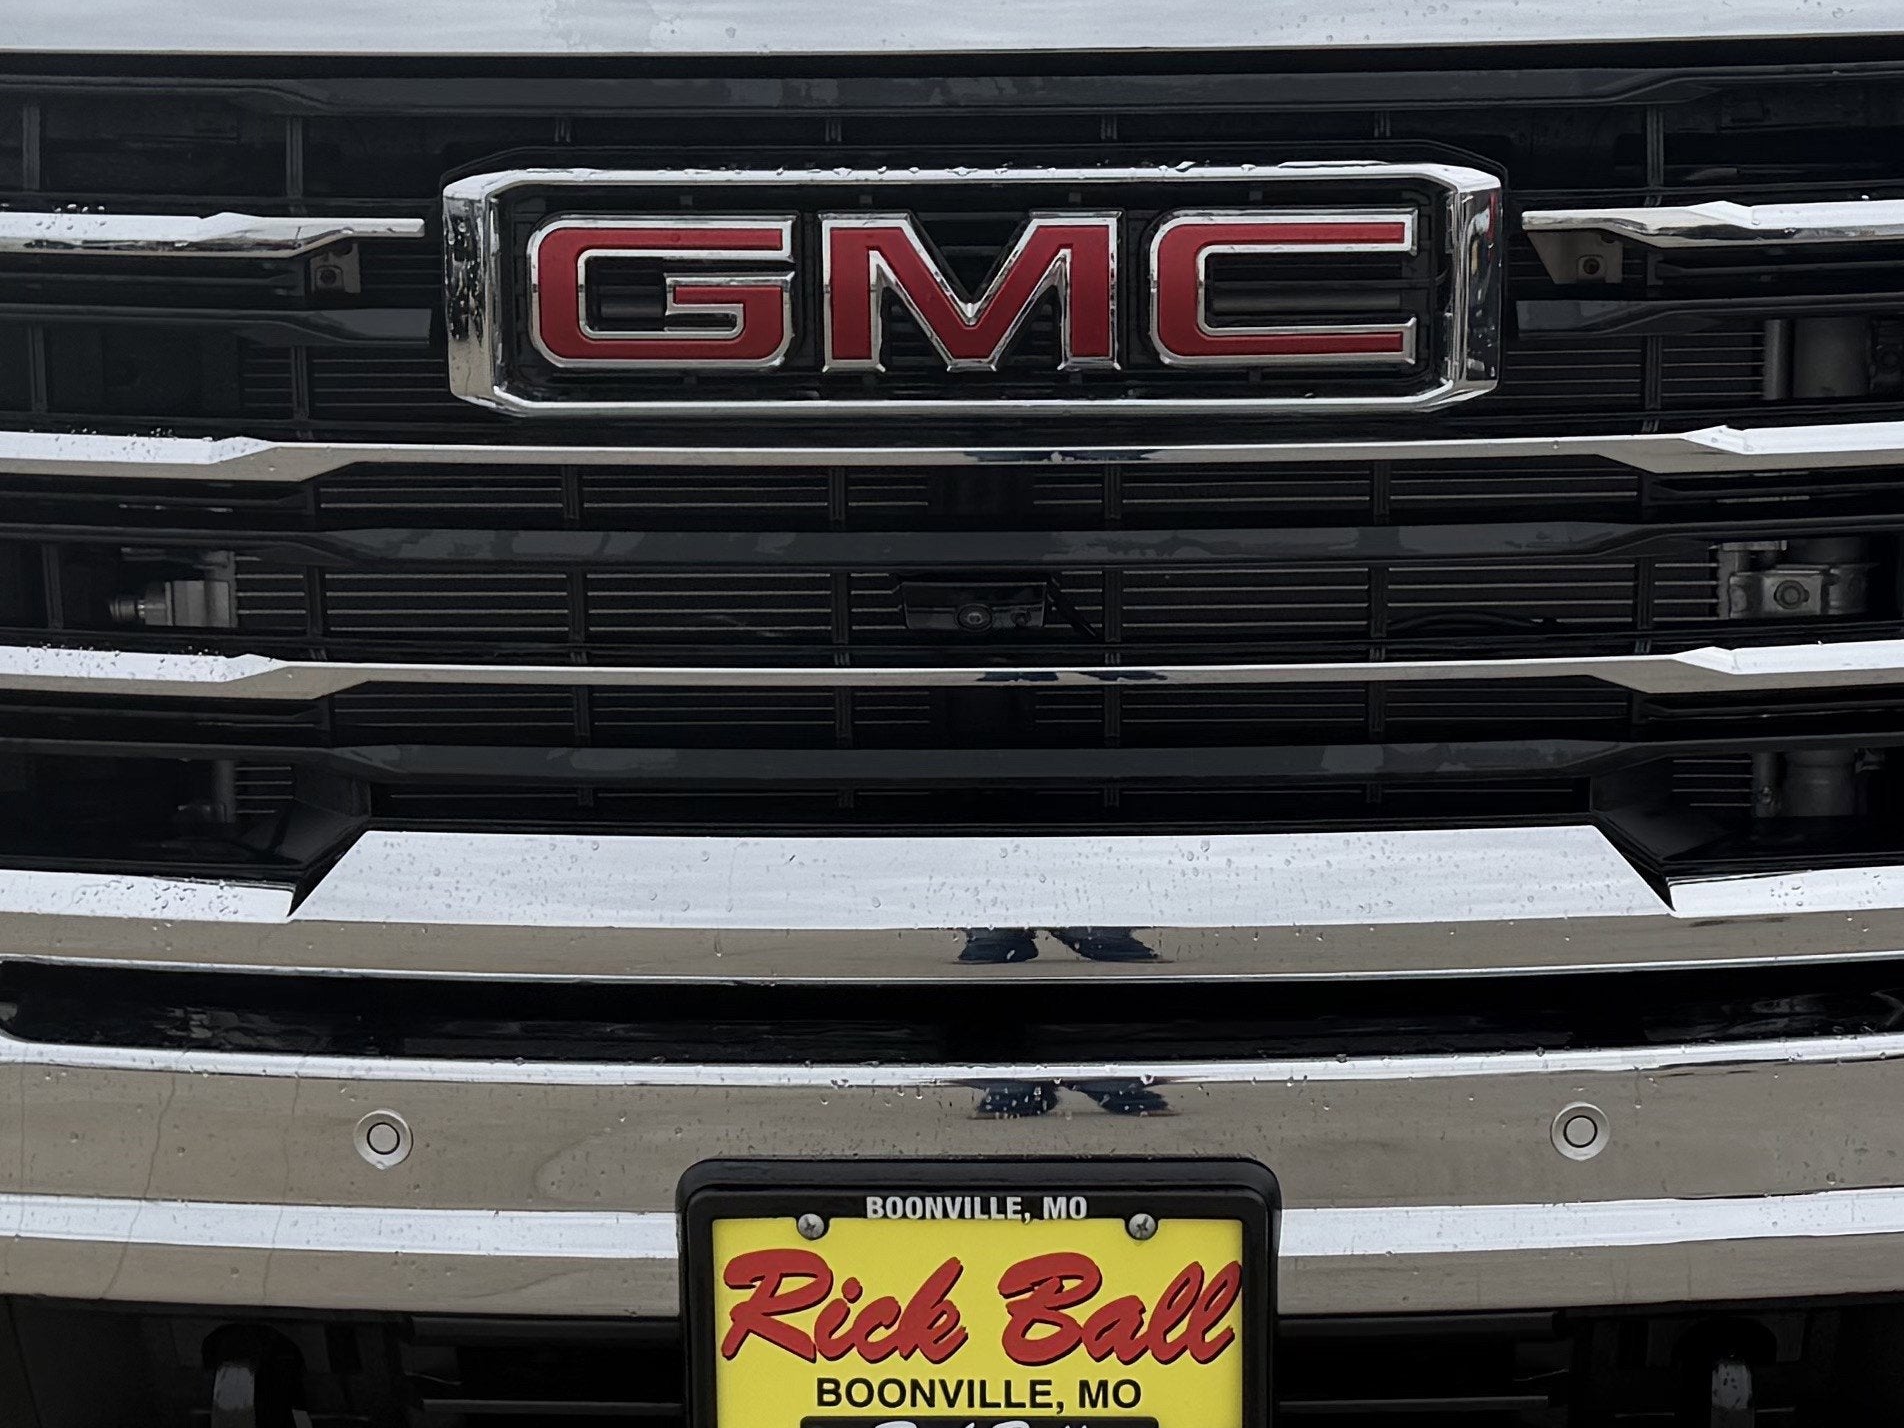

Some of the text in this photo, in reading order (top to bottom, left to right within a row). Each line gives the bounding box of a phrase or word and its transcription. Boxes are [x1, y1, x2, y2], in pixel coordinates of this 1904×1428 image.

[526, 208, 1420, 373] GMC
[865, 1195, 1088, 1224] BOONVILLE, MO
[720, 1248, 1243, 1365] Rick Ball
[816, 1377, 1142, 1414] BOONVILLE, MO
